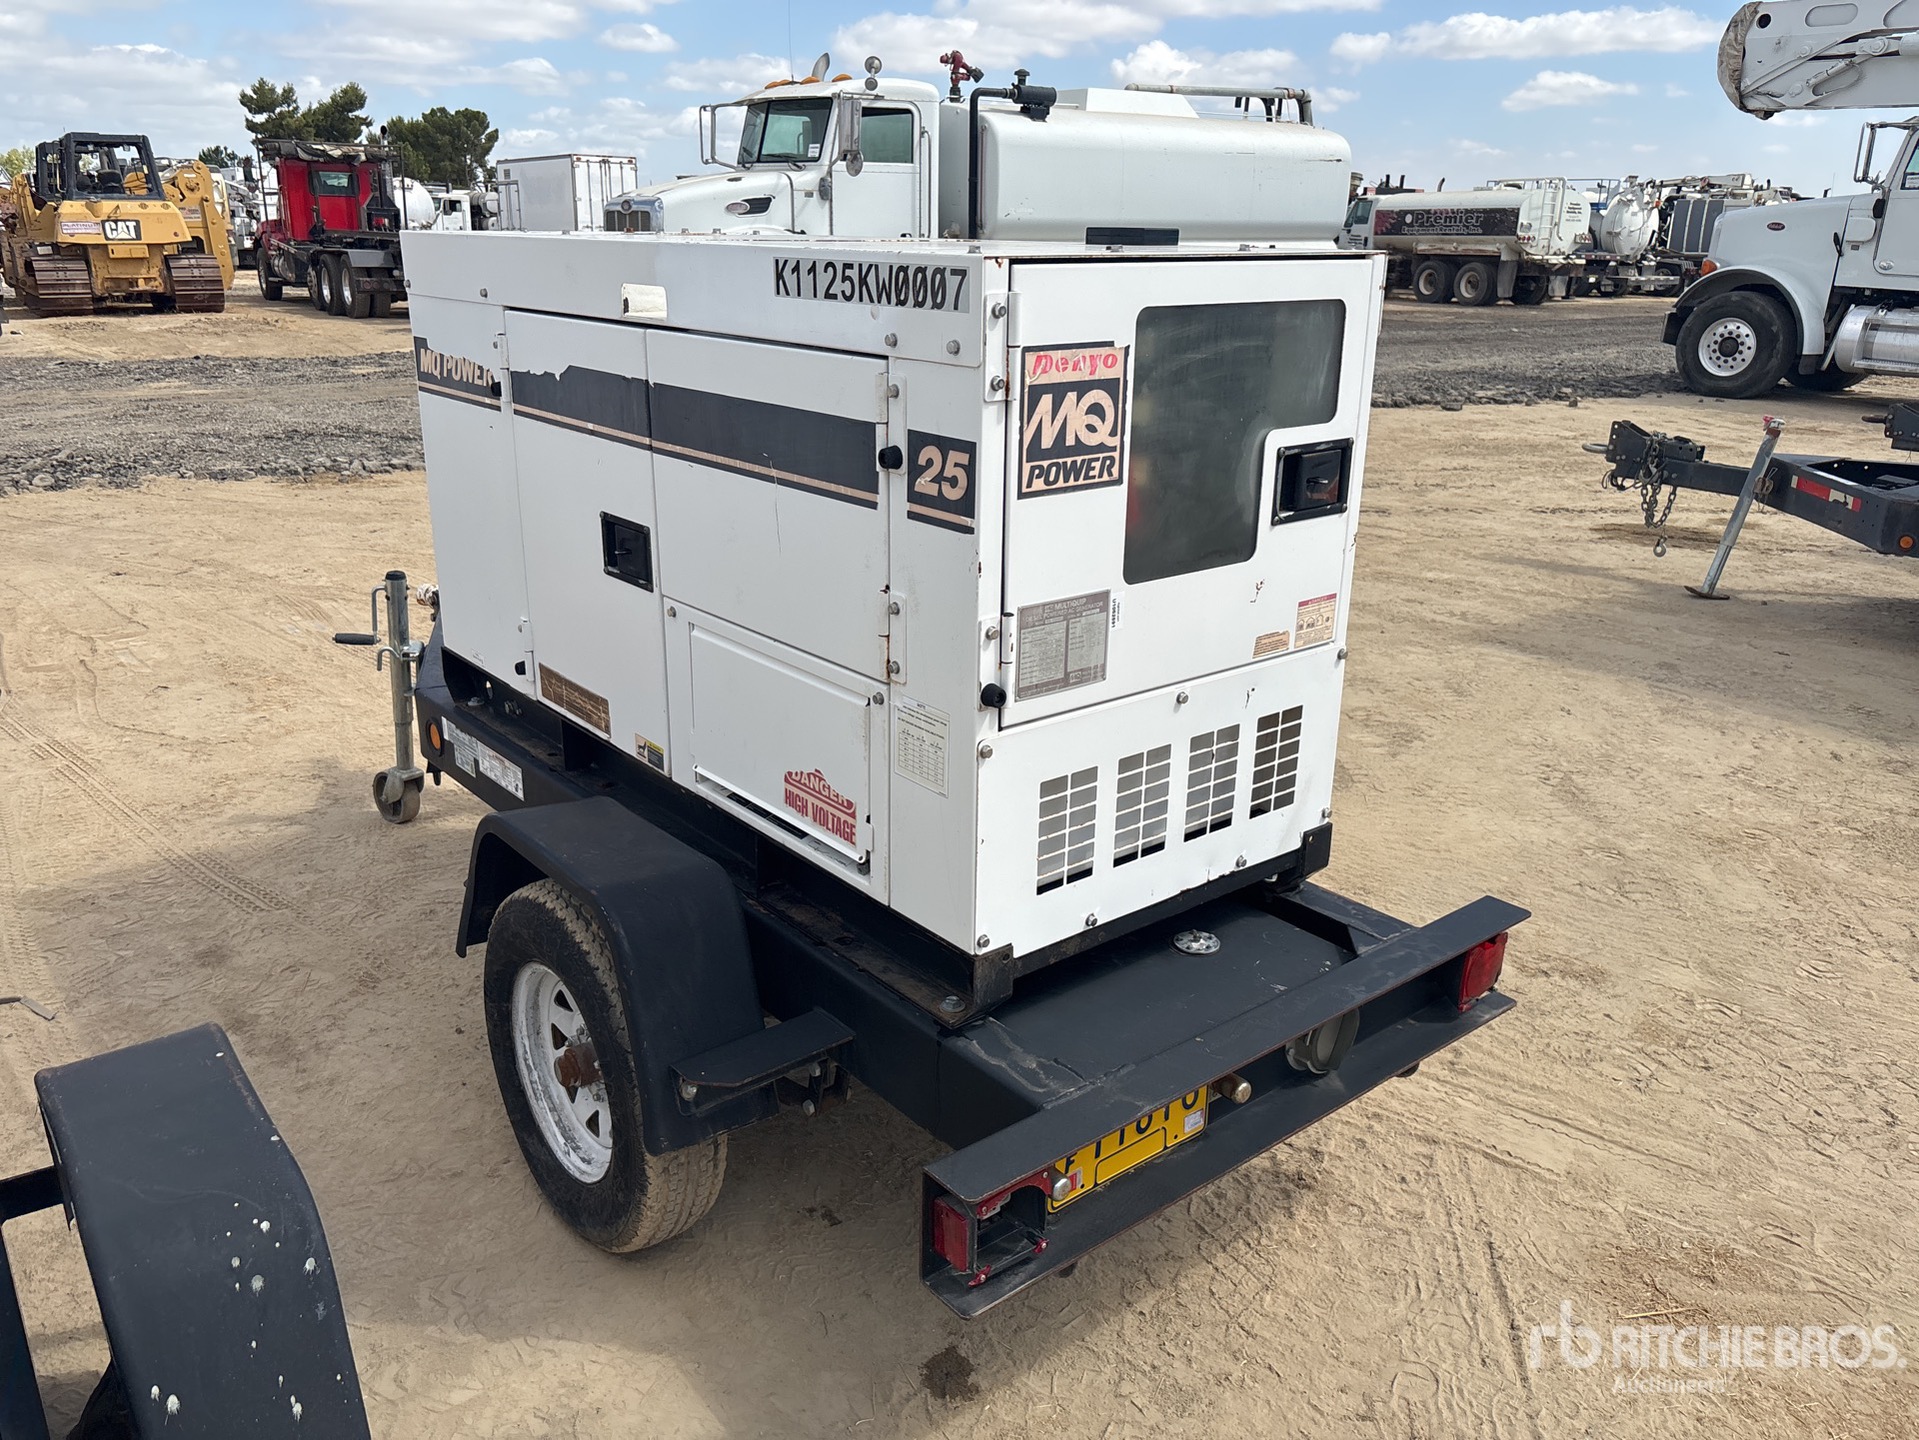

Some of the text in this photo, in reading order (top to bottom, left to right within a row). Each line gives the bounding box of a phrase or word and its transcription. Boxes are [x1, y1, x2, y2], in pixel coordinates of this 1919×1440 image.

[104, 221, 137, 240] CAT
[1401, 226, 1439, 235] Equipment
[1413, 210, 1484, 226] Premier
[774, 258, 968, 311] K1125KW0007
[420, 348, 441, 380] MQ
[1032, 353, 1118, 376] Denyo
[1024, 389, 1120, 450] MQ
[913, 445, 971, 501] 25
[1026, 455, 1117, 489] POWER
[785, 788, 856, 845] HIGH VOLTAGE
